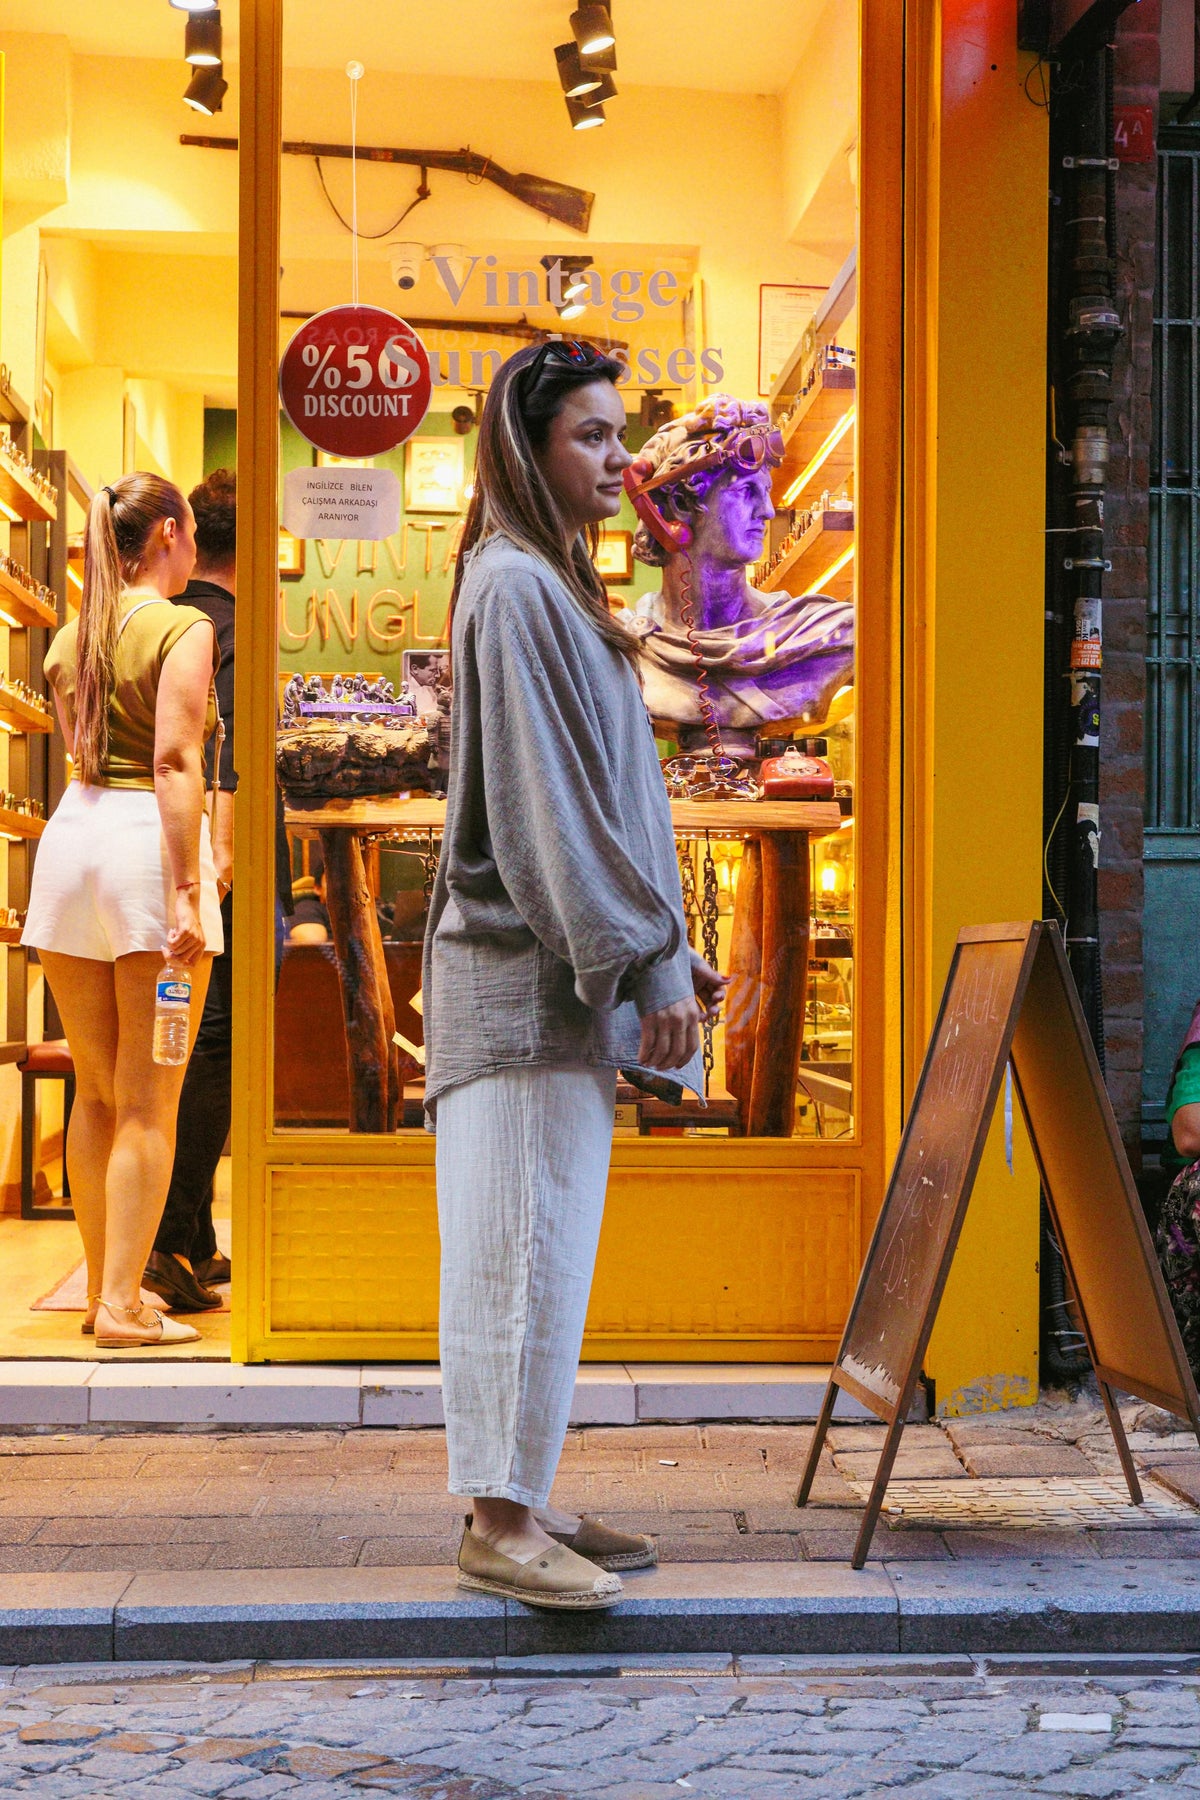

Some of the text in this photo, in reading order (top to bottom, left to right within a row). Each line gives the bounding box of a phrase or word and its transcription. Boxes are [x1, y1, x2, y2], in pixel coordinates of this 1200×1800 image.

[431, 254, 678, 323] Vintage
[302, 344, 411, 389] %50
[303, 394, 413, 417] DISCOUNT
[350, 483, 373, 492] BİLEN
[301, 497, 378, 508] ÇALIŞMA ARKADAŞI
[318, 512, 360, 522] ARANIYOR
